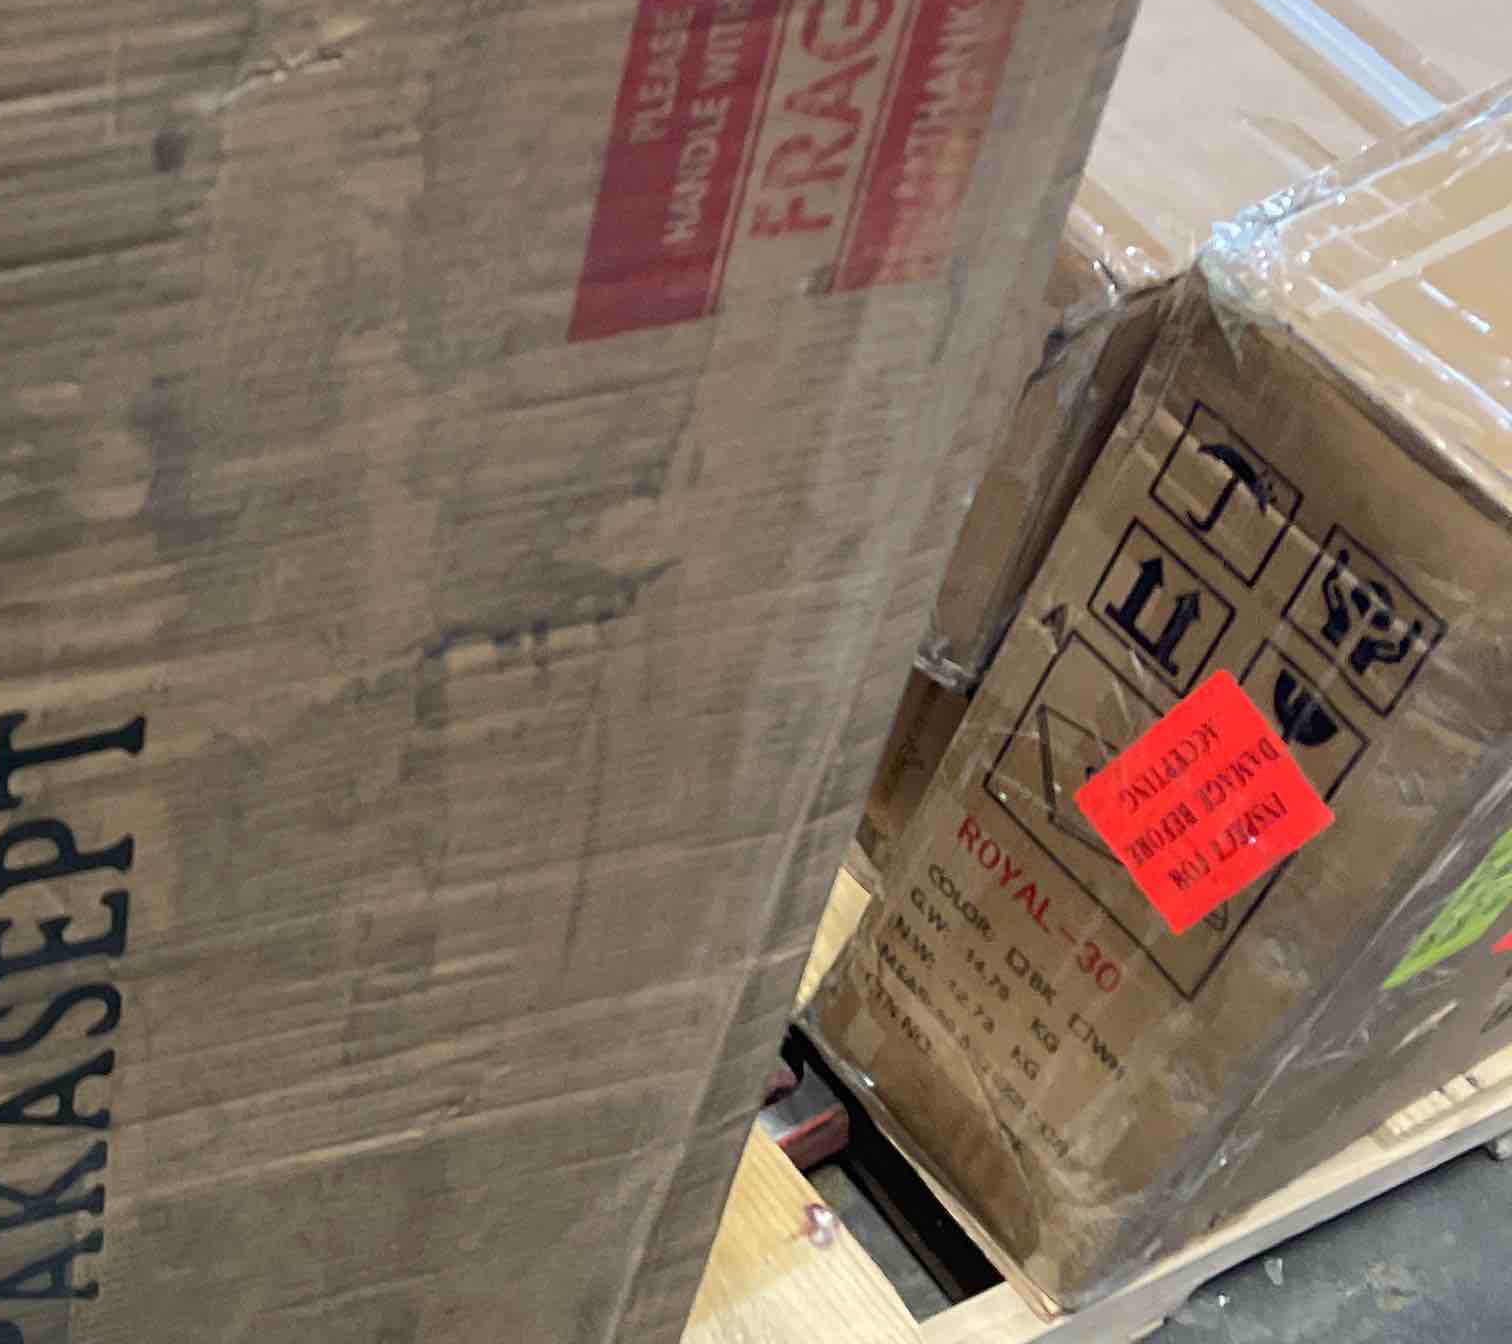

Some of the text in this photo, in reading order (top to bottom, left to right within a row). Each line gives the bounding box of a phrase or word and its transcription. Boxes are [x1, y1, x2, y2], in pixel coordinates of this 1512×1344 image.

[631, 7, 694, 144] PLEASE
[902, 4, 984, 159] THANK
[664, 97, 731, 244] HANDLE
[1116, 720, 1222, 815] ACCEPTING
[1124, 736, 1281, 869] DAMAGE BEFORE
[1165, 791, 1290, 892] INSPECT FOR
[1029, 1016, 1060, 1054] KG
